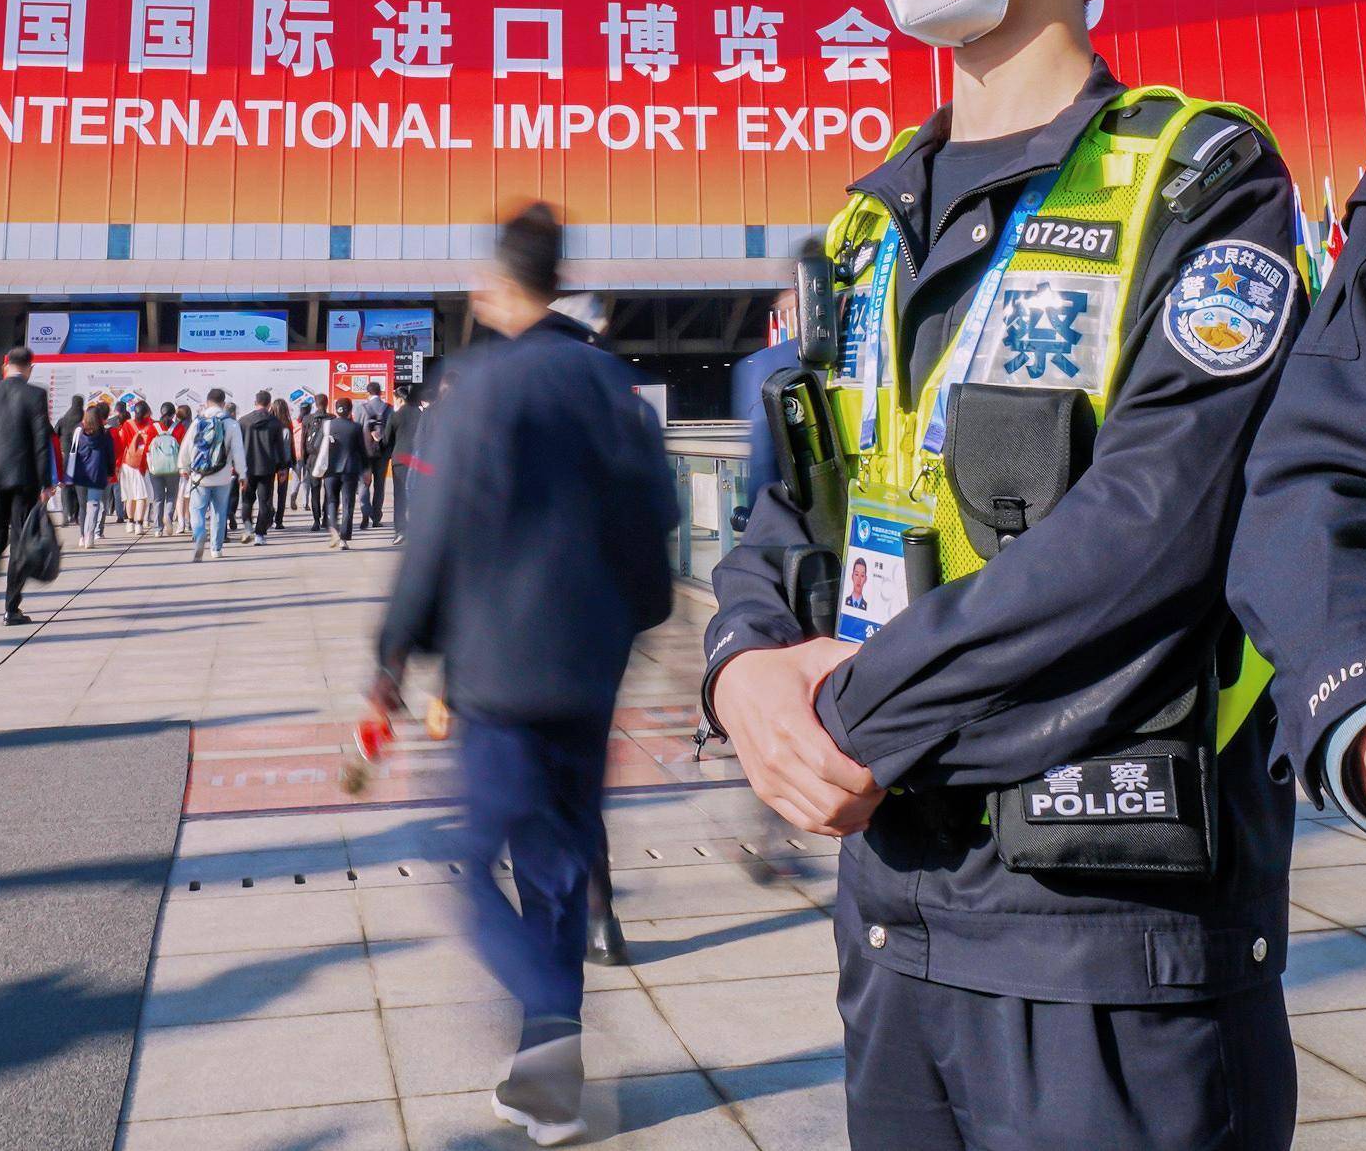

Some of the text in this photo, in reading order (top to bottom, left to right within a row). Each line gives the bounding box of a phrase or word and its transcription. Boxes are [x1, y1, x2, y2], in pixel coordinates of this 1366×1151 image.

[493, 103, 717, 151] IMPORT
[737, 106, 892, 152] EXPO
[1202, 158, 1233, 186] POLICE
[1024, 222, 1113, 253] 072267
[1202, 295, 1249, 312] POLICE
[1031, 791, 1166, 816] POLICE
